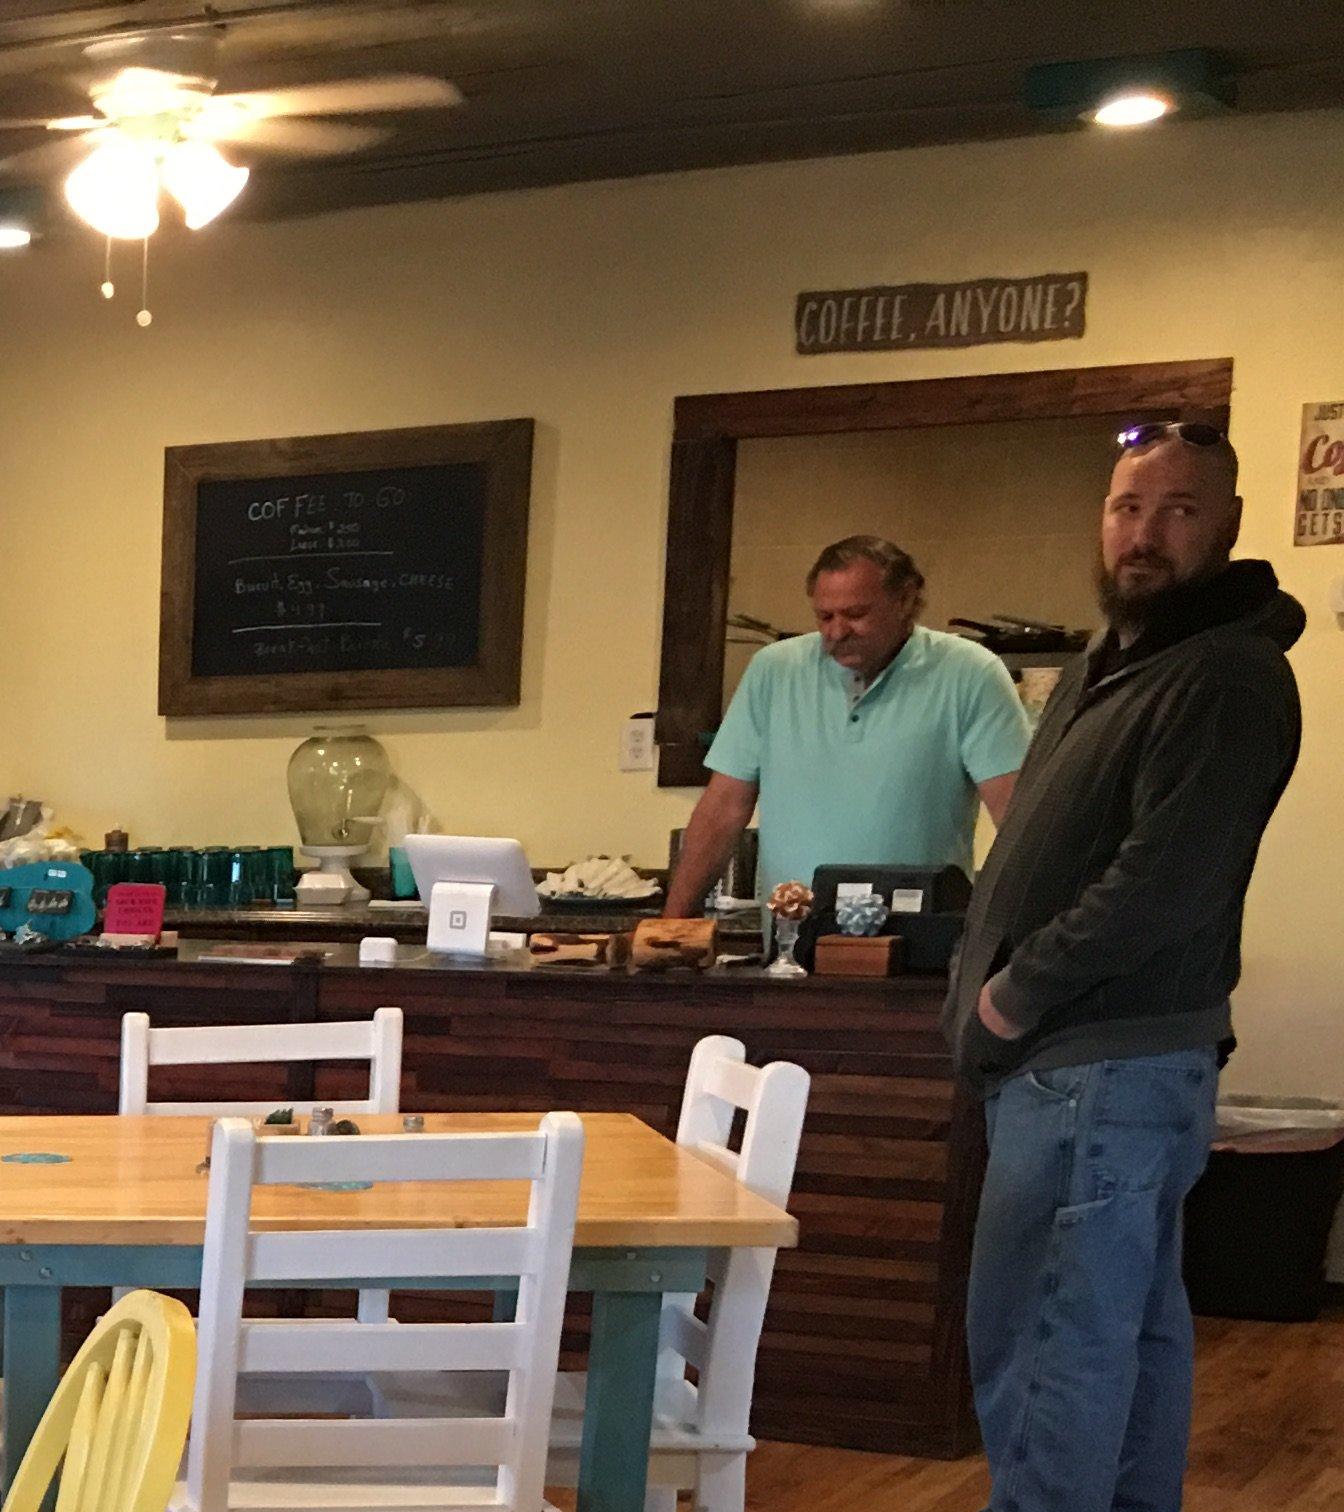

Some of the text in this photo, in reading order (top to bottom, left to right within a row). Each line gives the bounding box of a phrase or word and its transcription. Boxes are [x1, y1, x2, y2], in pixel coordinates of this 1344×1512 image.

[799, 282, 1081, 346] COFFEE, ANYONE?
[248, 486, 406, 521] COFFEE TO GO
